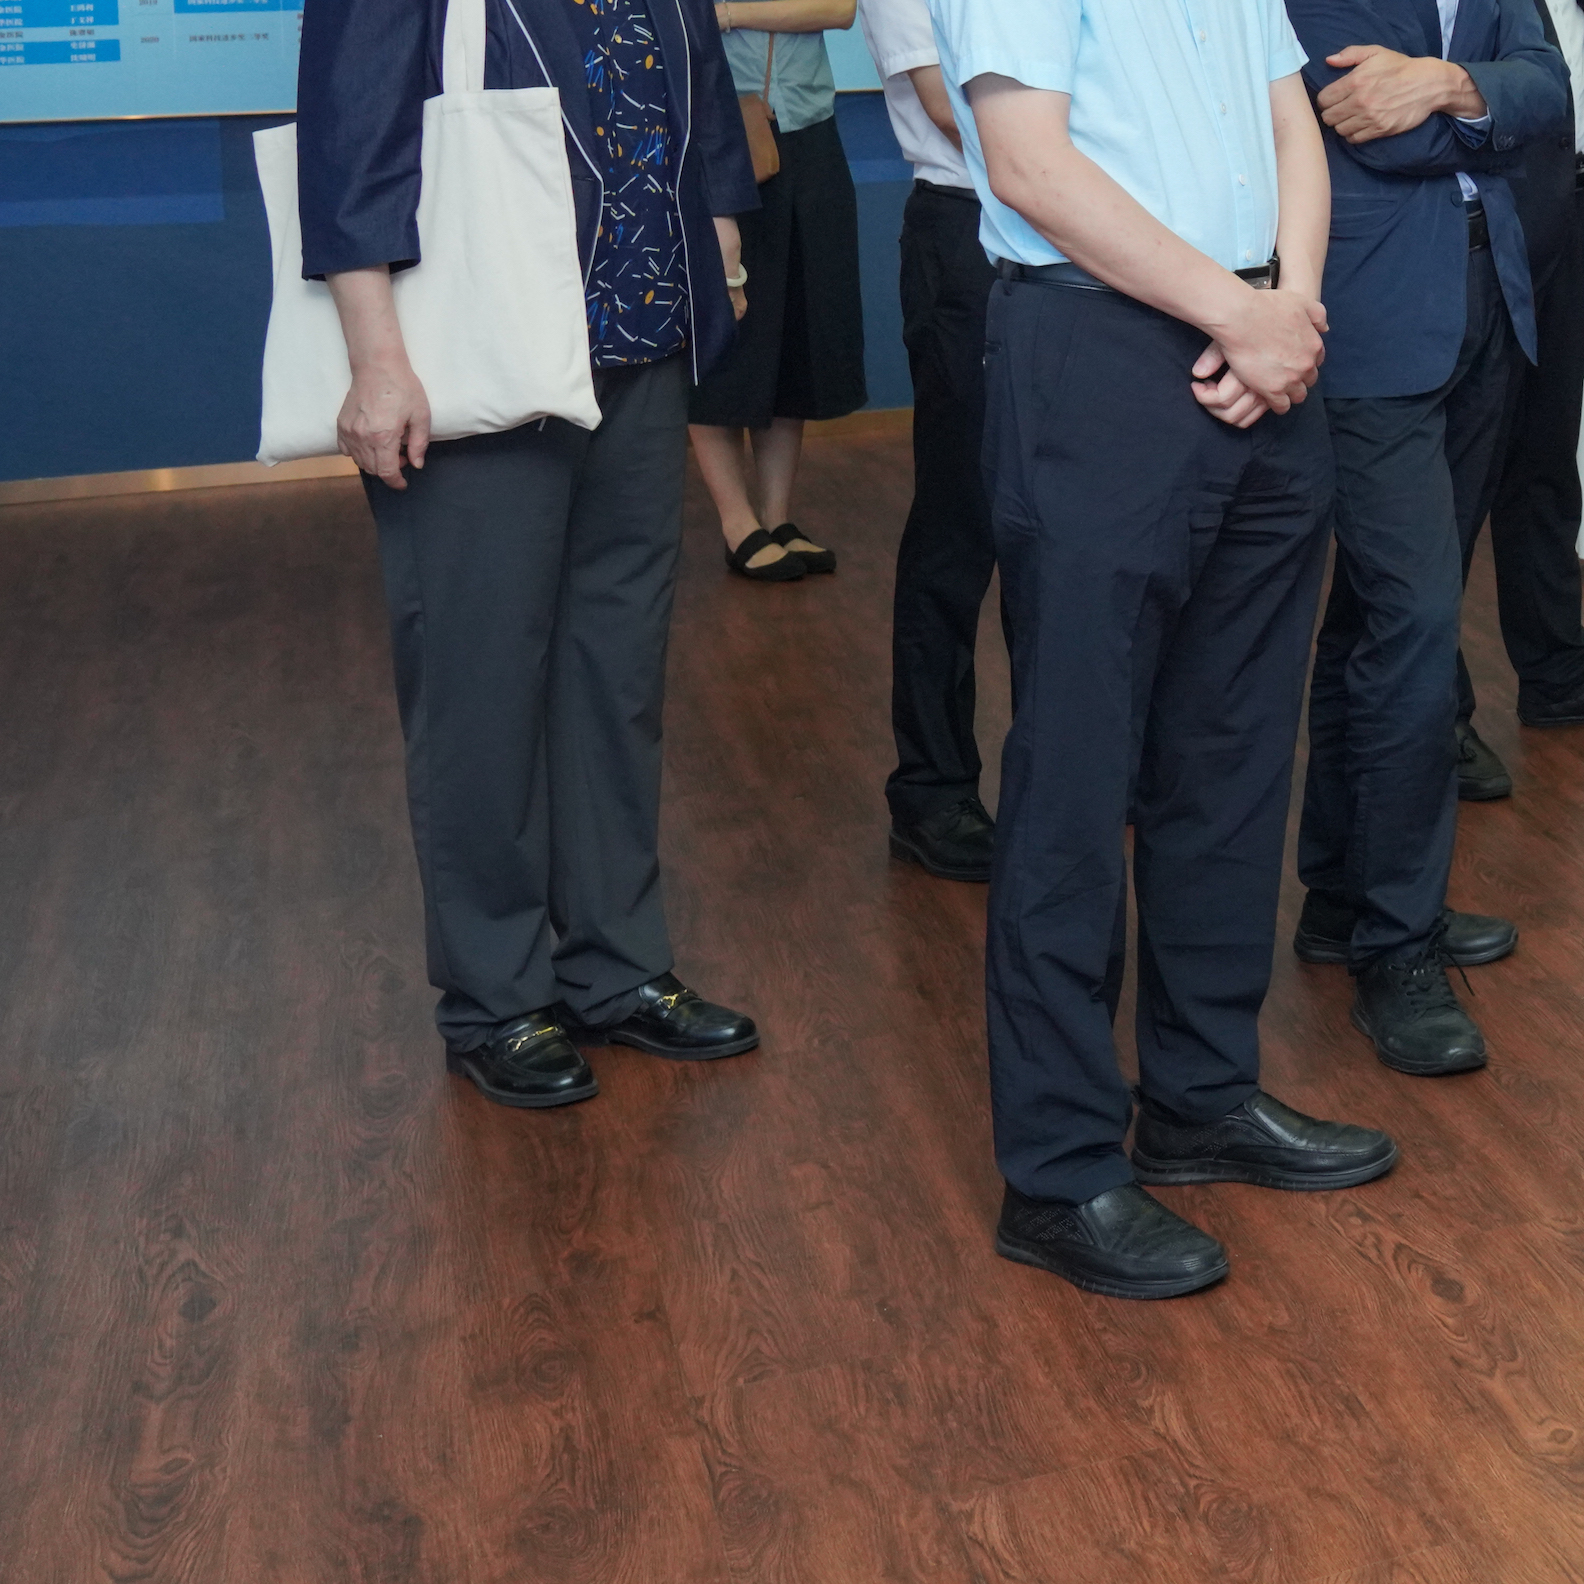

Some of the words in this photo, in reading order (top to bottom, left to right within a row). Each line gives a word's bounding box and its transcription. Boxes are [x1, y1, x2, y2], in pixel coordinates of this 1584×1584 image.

[189, 33, 269, 43] 国家科技进步奖二等奖
